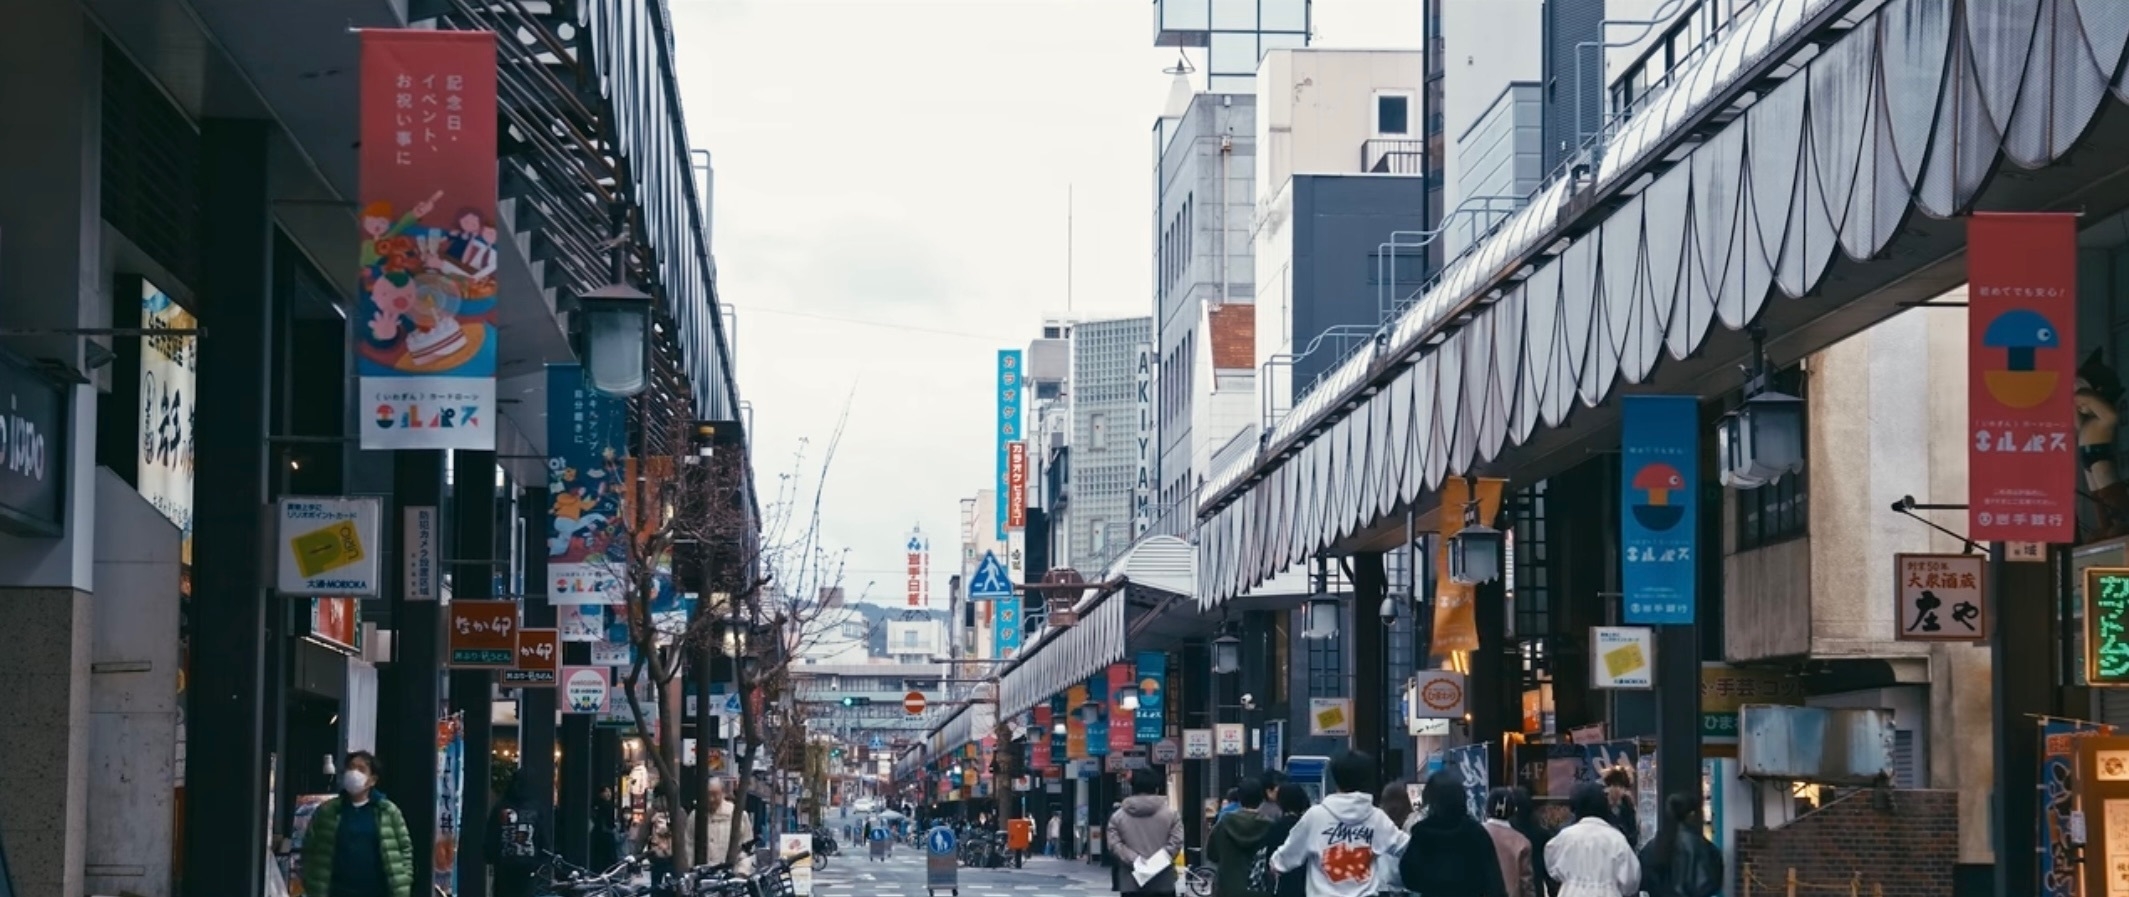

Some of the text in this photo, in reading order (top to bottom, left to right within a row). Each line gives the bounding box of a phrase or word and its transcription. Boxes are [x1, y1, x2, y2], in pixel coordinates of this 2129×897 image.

[397, 74, 412, 165] お祝い事に
[422, 74, 438, 151] イベント、
[1012, 445, 1023, 482] カラオケ
[1906, 590, 1979, 632] 庄や
[455, 615, 512, 637] なか卯
[521, 643, 553, 661] か卯
[1704, 715, 1739, 730] ひま
[1520, 761, 1544, 780] 4F
